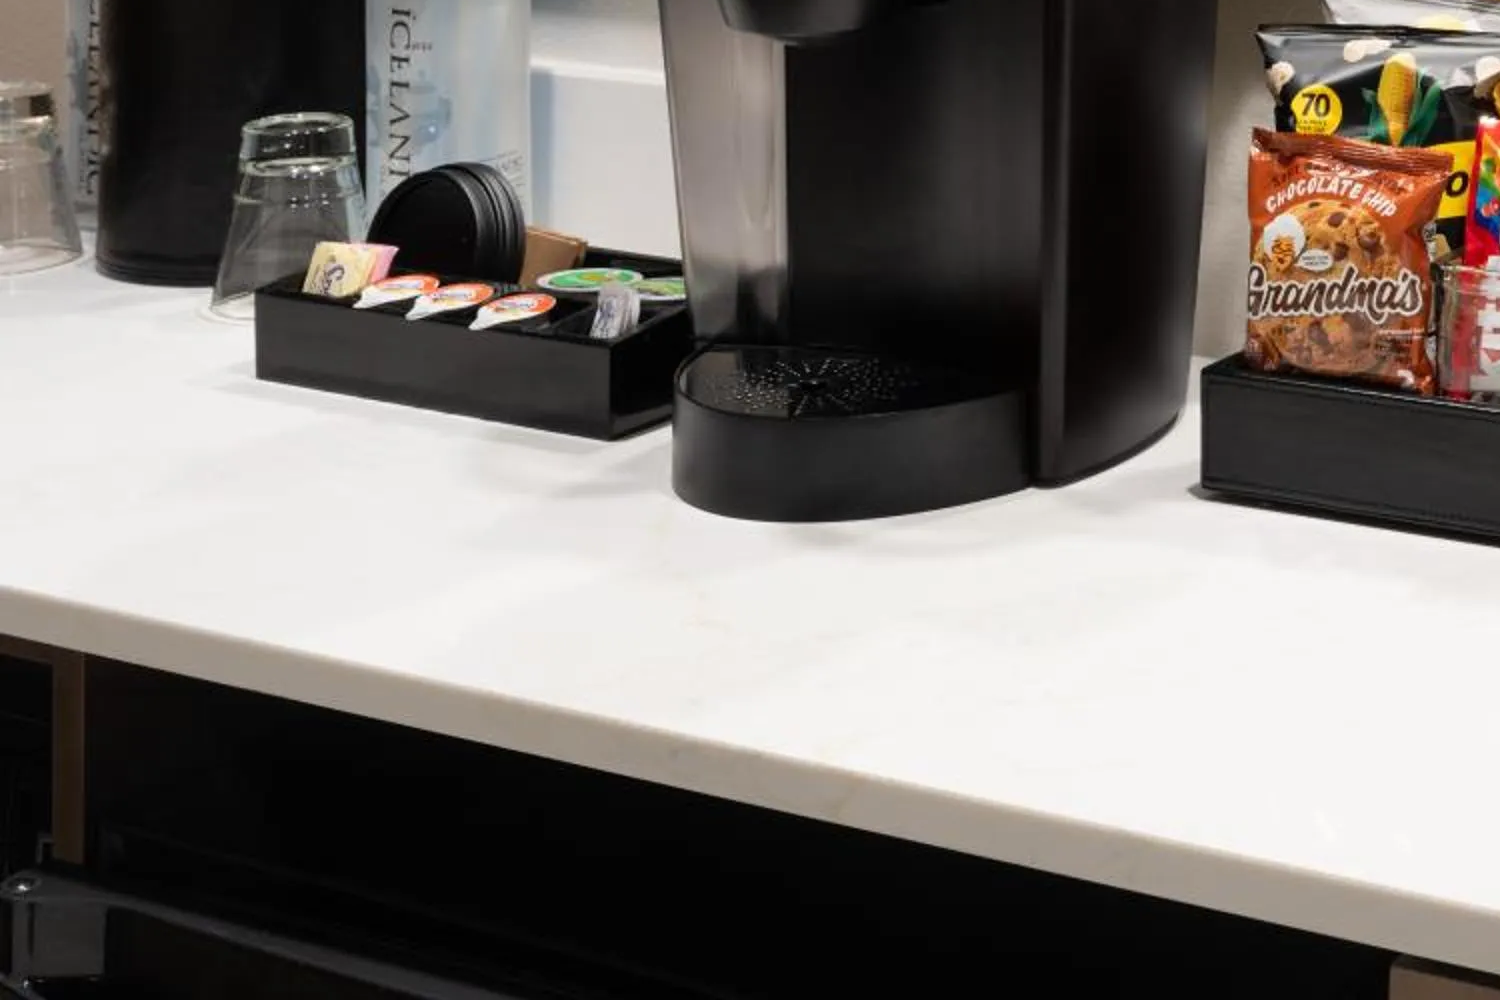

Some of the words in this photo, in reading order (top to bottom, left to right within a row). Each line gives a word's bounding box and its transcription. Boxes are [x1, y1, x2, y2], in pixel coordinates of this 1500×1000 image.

[1302, 93, 1331, 118] 70
[1264, 176, 1364, 214] CHOCOLATE
[1360, 189, 1398, 218] CHIP
